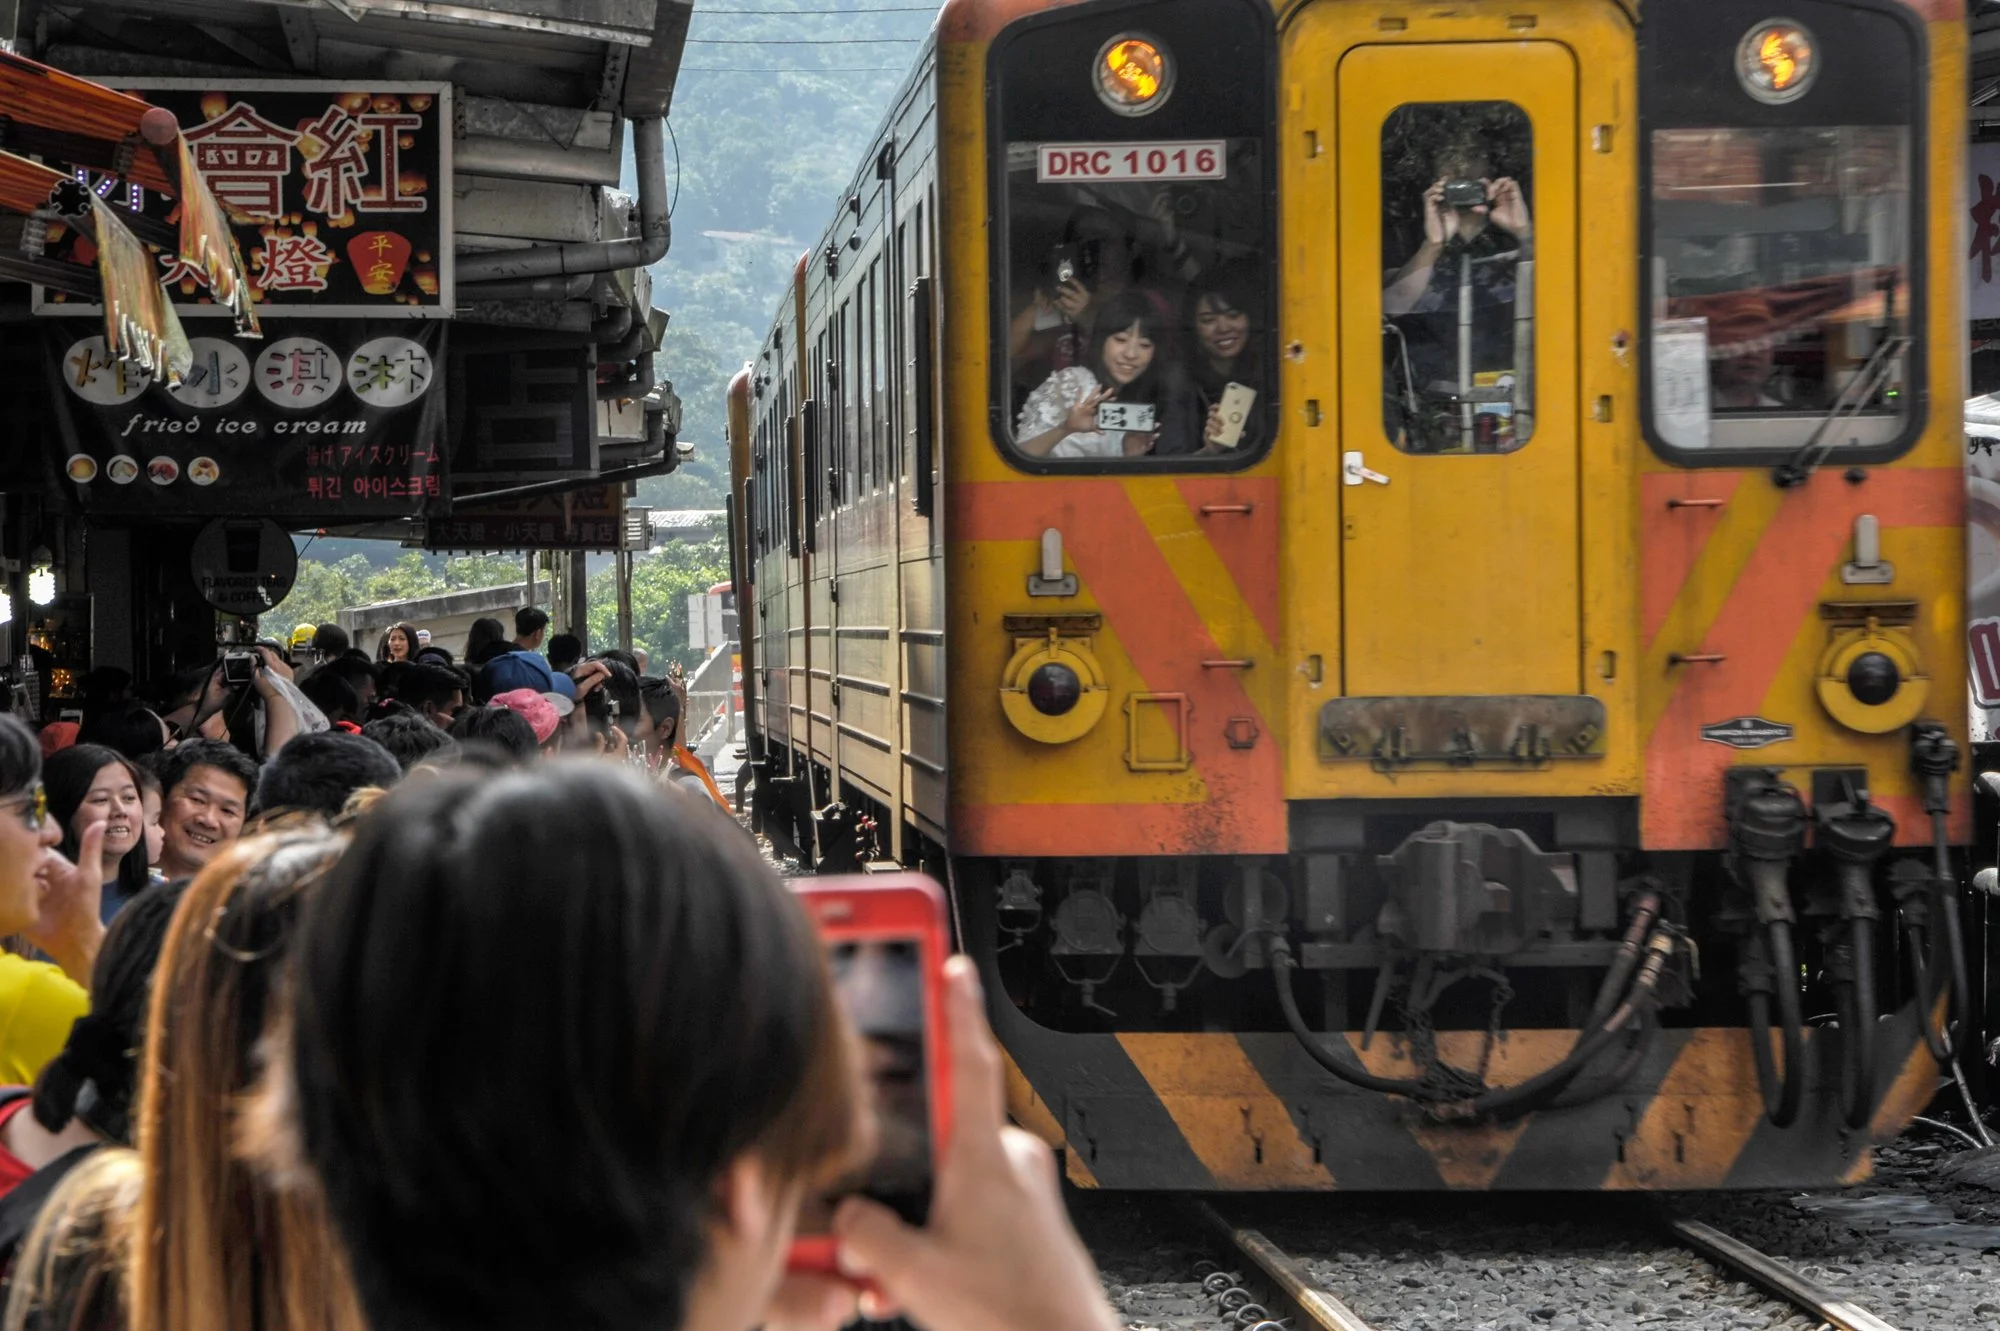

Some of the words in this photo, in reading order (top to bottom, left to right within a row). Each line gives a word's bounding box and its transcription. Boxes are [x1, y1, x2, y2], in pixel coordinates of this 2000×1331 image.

[1048, 151, 1112, 176] DRC
[1123, 149, 1216, 174] 1016
[367, 234, 396, 282] 平安
[121, 413, 201, 437] fried
[215, 416, 258, 435] ice
[273, 419, 369, 435] cream
[352, 473, 441, 499] 아이스크림
[202, 577, 256, 589] FLAVORED
